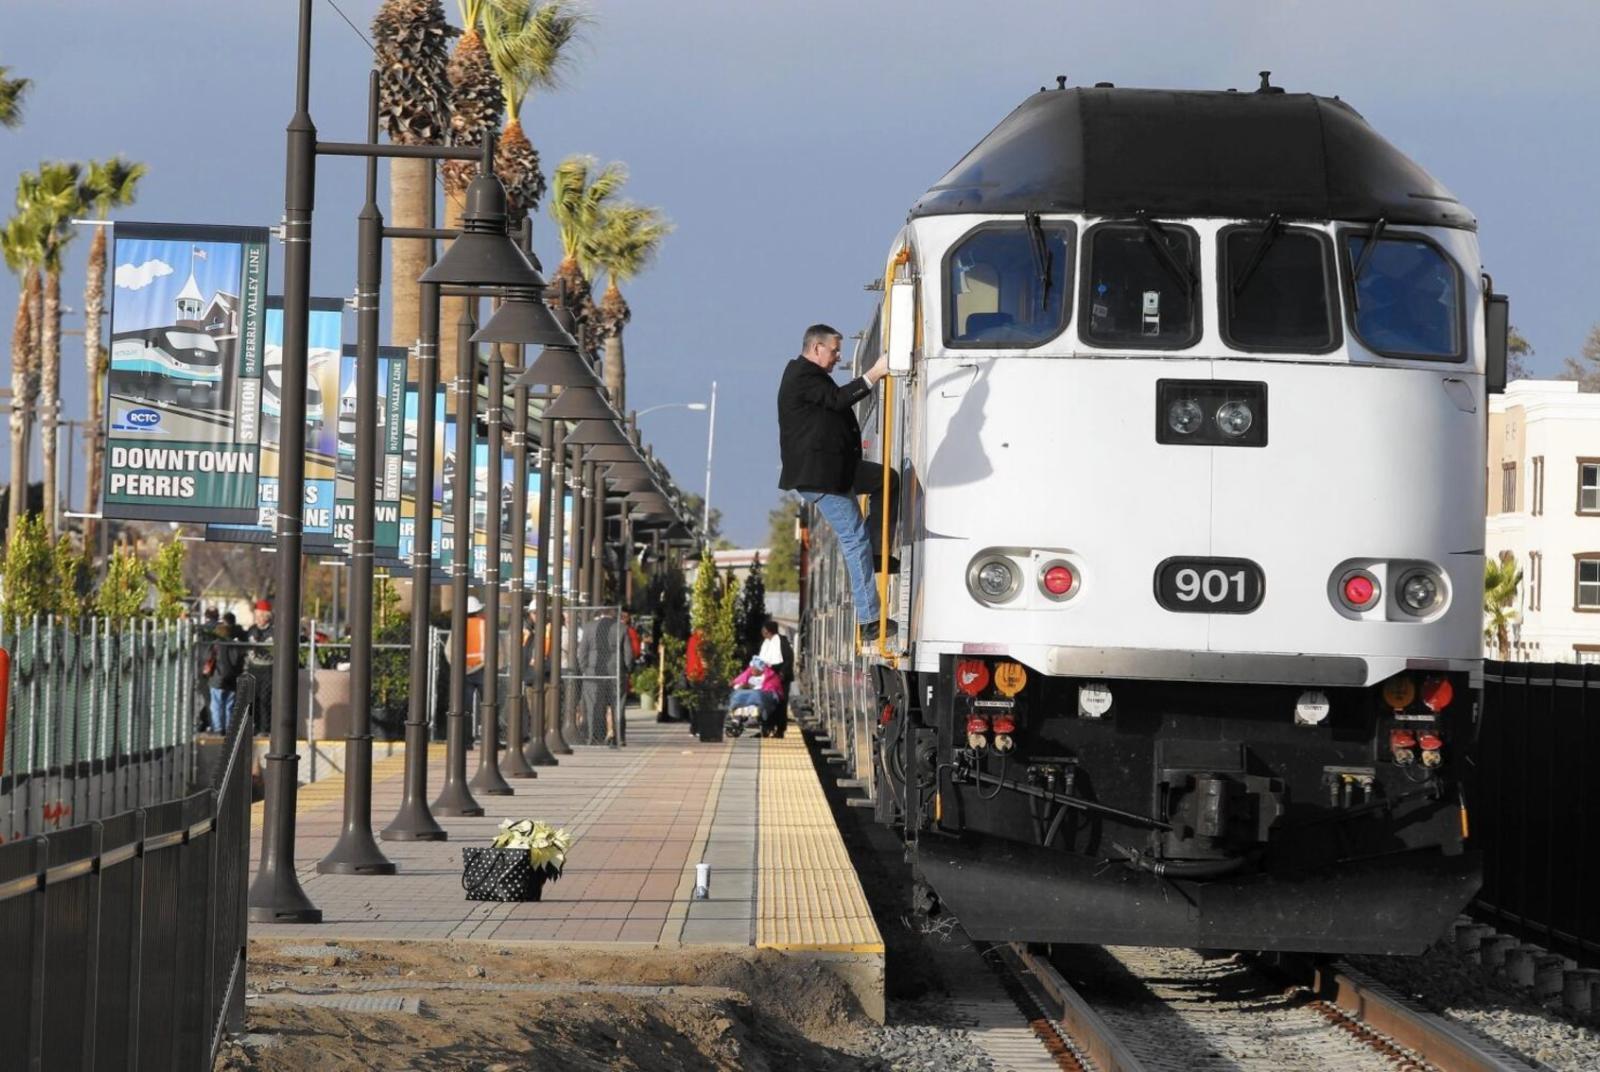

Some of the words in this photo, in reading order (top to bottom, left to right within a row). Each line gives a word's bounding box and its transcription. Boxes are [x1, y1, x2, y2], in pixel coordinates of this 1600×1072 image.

[249, 248, 260, 274] LINE
[247, 277, 259, 317] VALLEY
[245, 320, 257, 374] 91/PERRIS
[241, 382, 256, 440] STATION
[391, 382, 401, 412] VALLEY
[130, 413, 158, 423] RCTC
[111, 446, 254, 474] DOWNTOWN
[110, 473, 196, 498] PERRIS
[386, 457, 399, 499] STATION
[1175, 568, 1246, 603] 901
